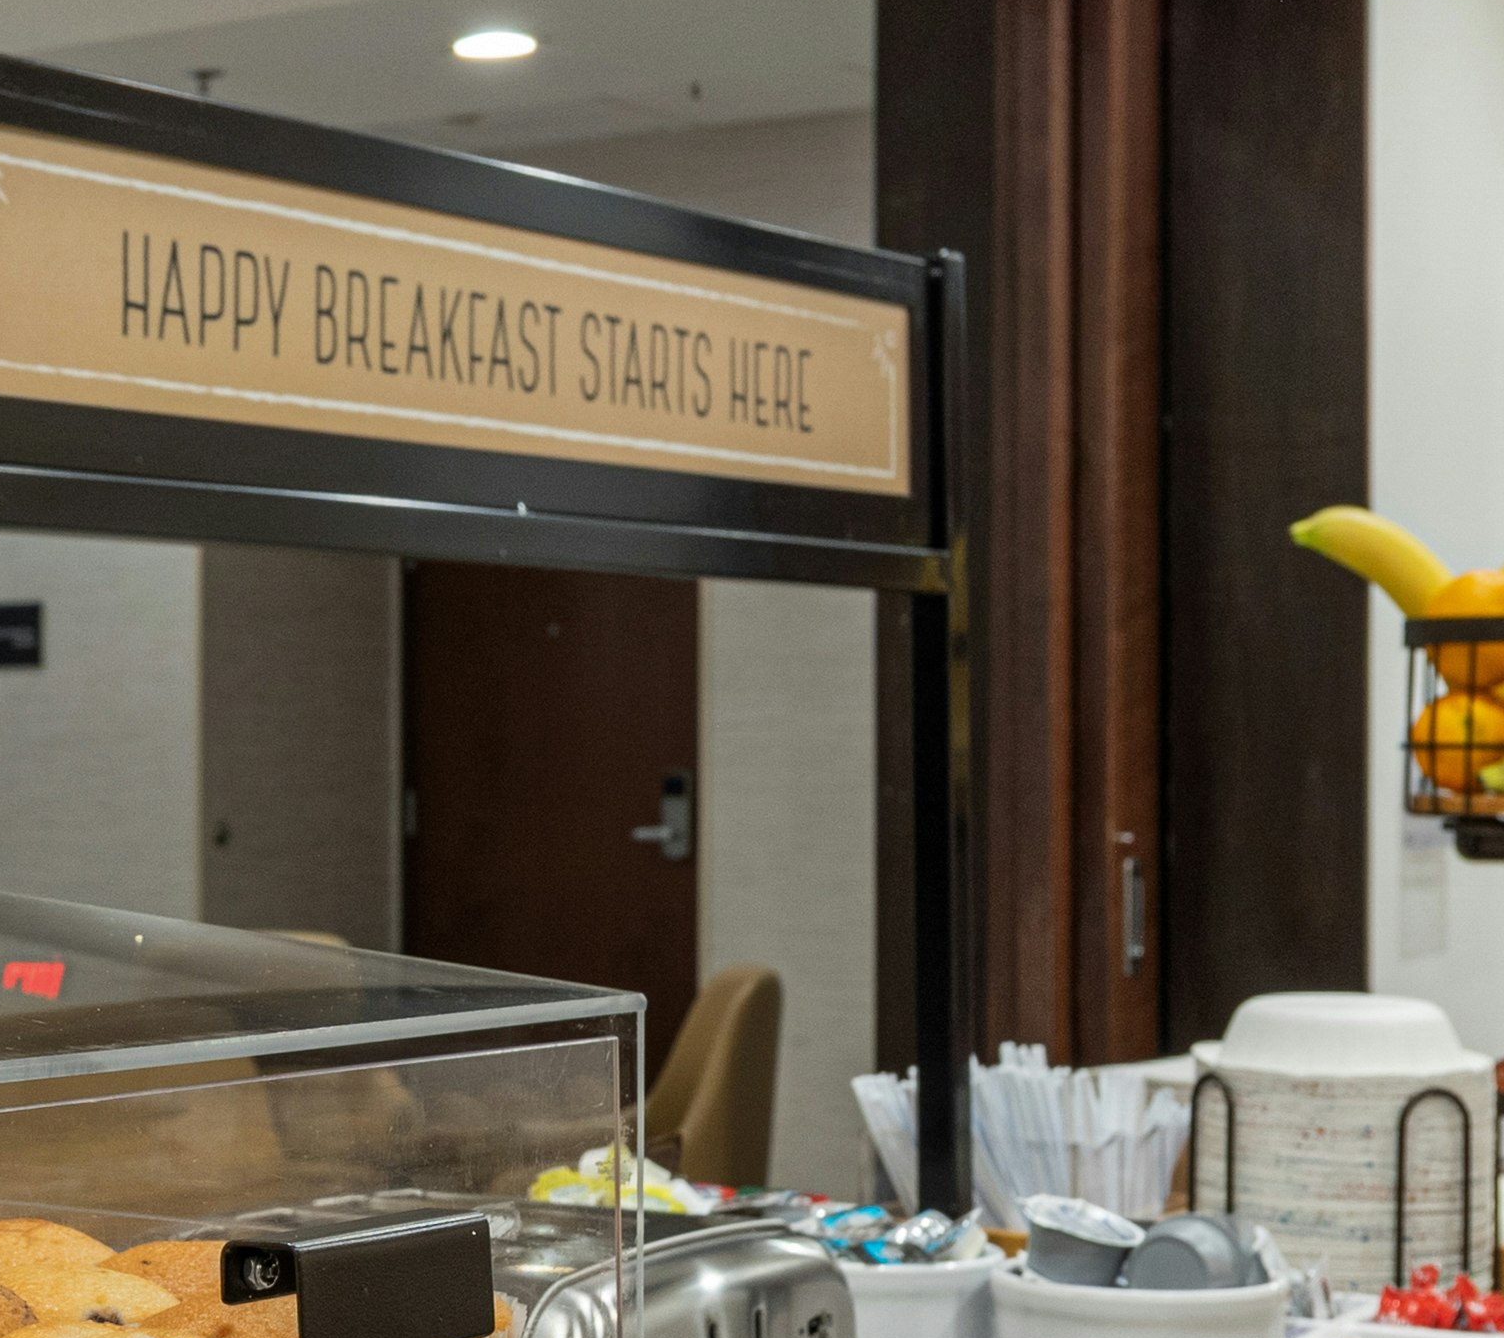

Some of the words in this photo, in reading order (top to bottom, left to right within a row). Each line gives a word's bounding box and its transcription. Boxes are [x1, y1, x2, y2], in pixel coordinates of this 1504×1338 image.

[121, 229, 290, 358] HAPPY
[314, 263, 562, 397] BREAKFAST
[579, 311, 713, 418] STARTS
[728, 336, 813, 434] HERE
